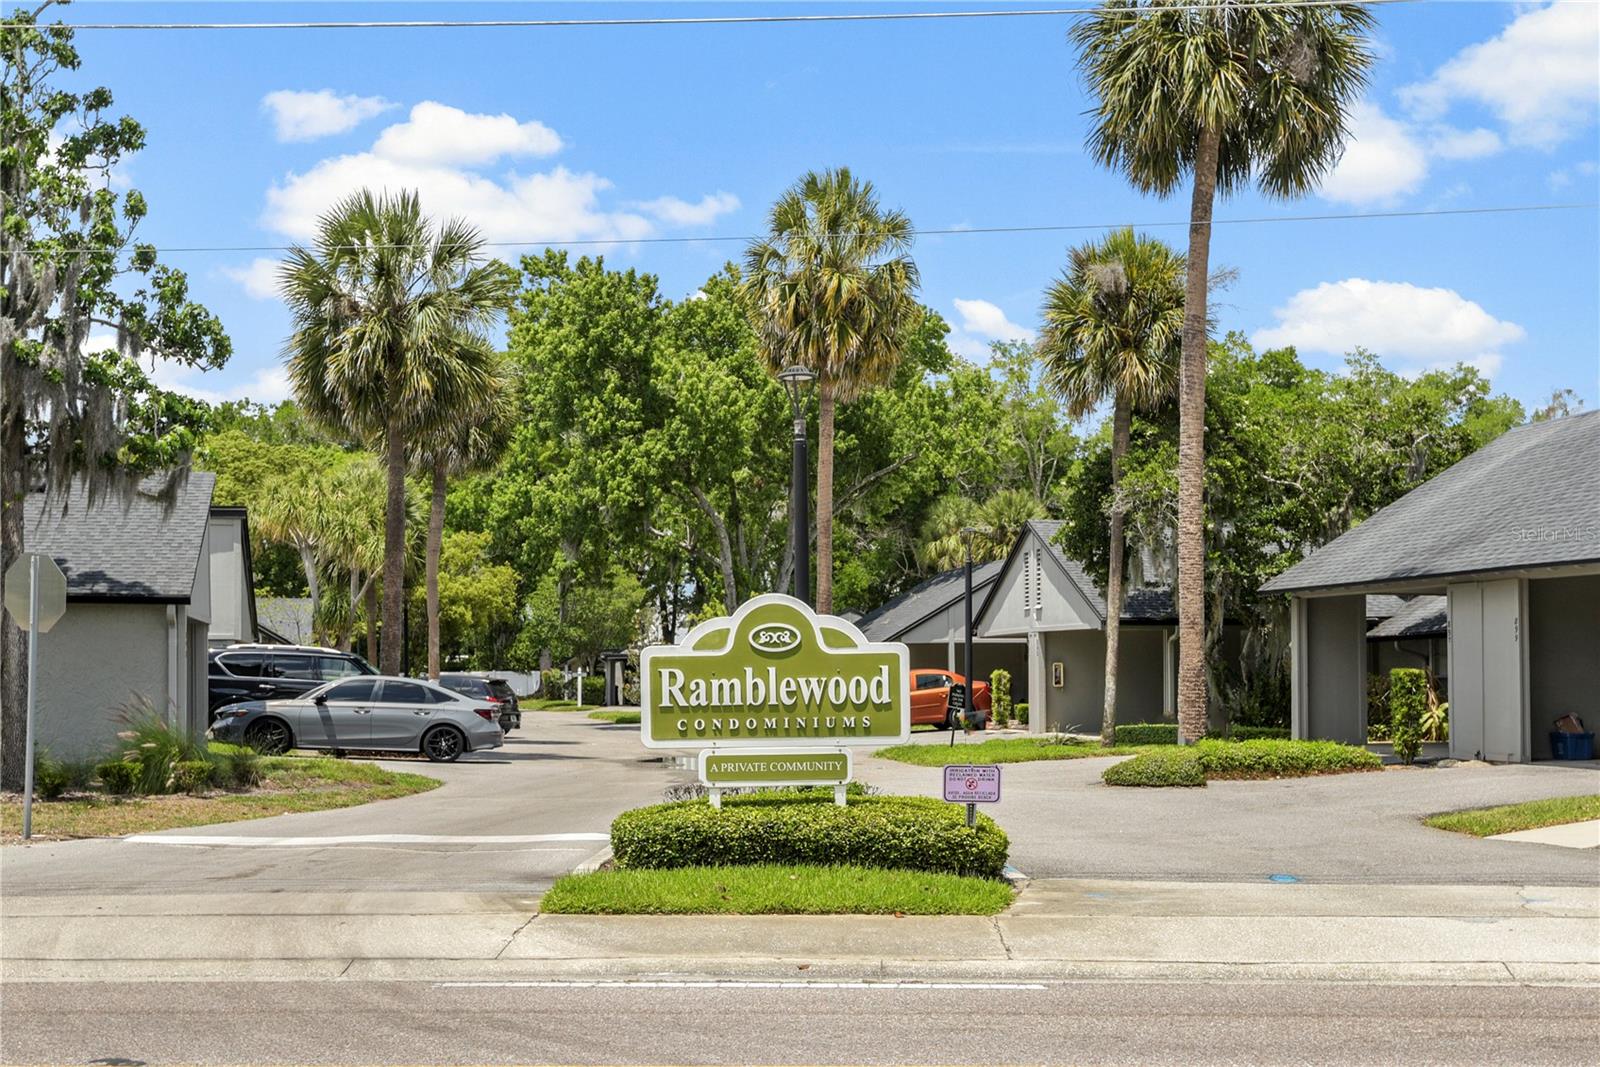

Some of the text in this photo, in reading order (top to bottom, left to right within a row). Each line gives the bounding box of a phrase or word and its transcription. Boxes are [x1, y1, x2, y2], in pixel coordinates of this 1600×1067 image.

[658, 665, 892, 707] Ramblewood
[677, 716, 871, 731] CONDOMINIUMS
[710, 761, 843, 773] A PRIVATE COMMUNITY
